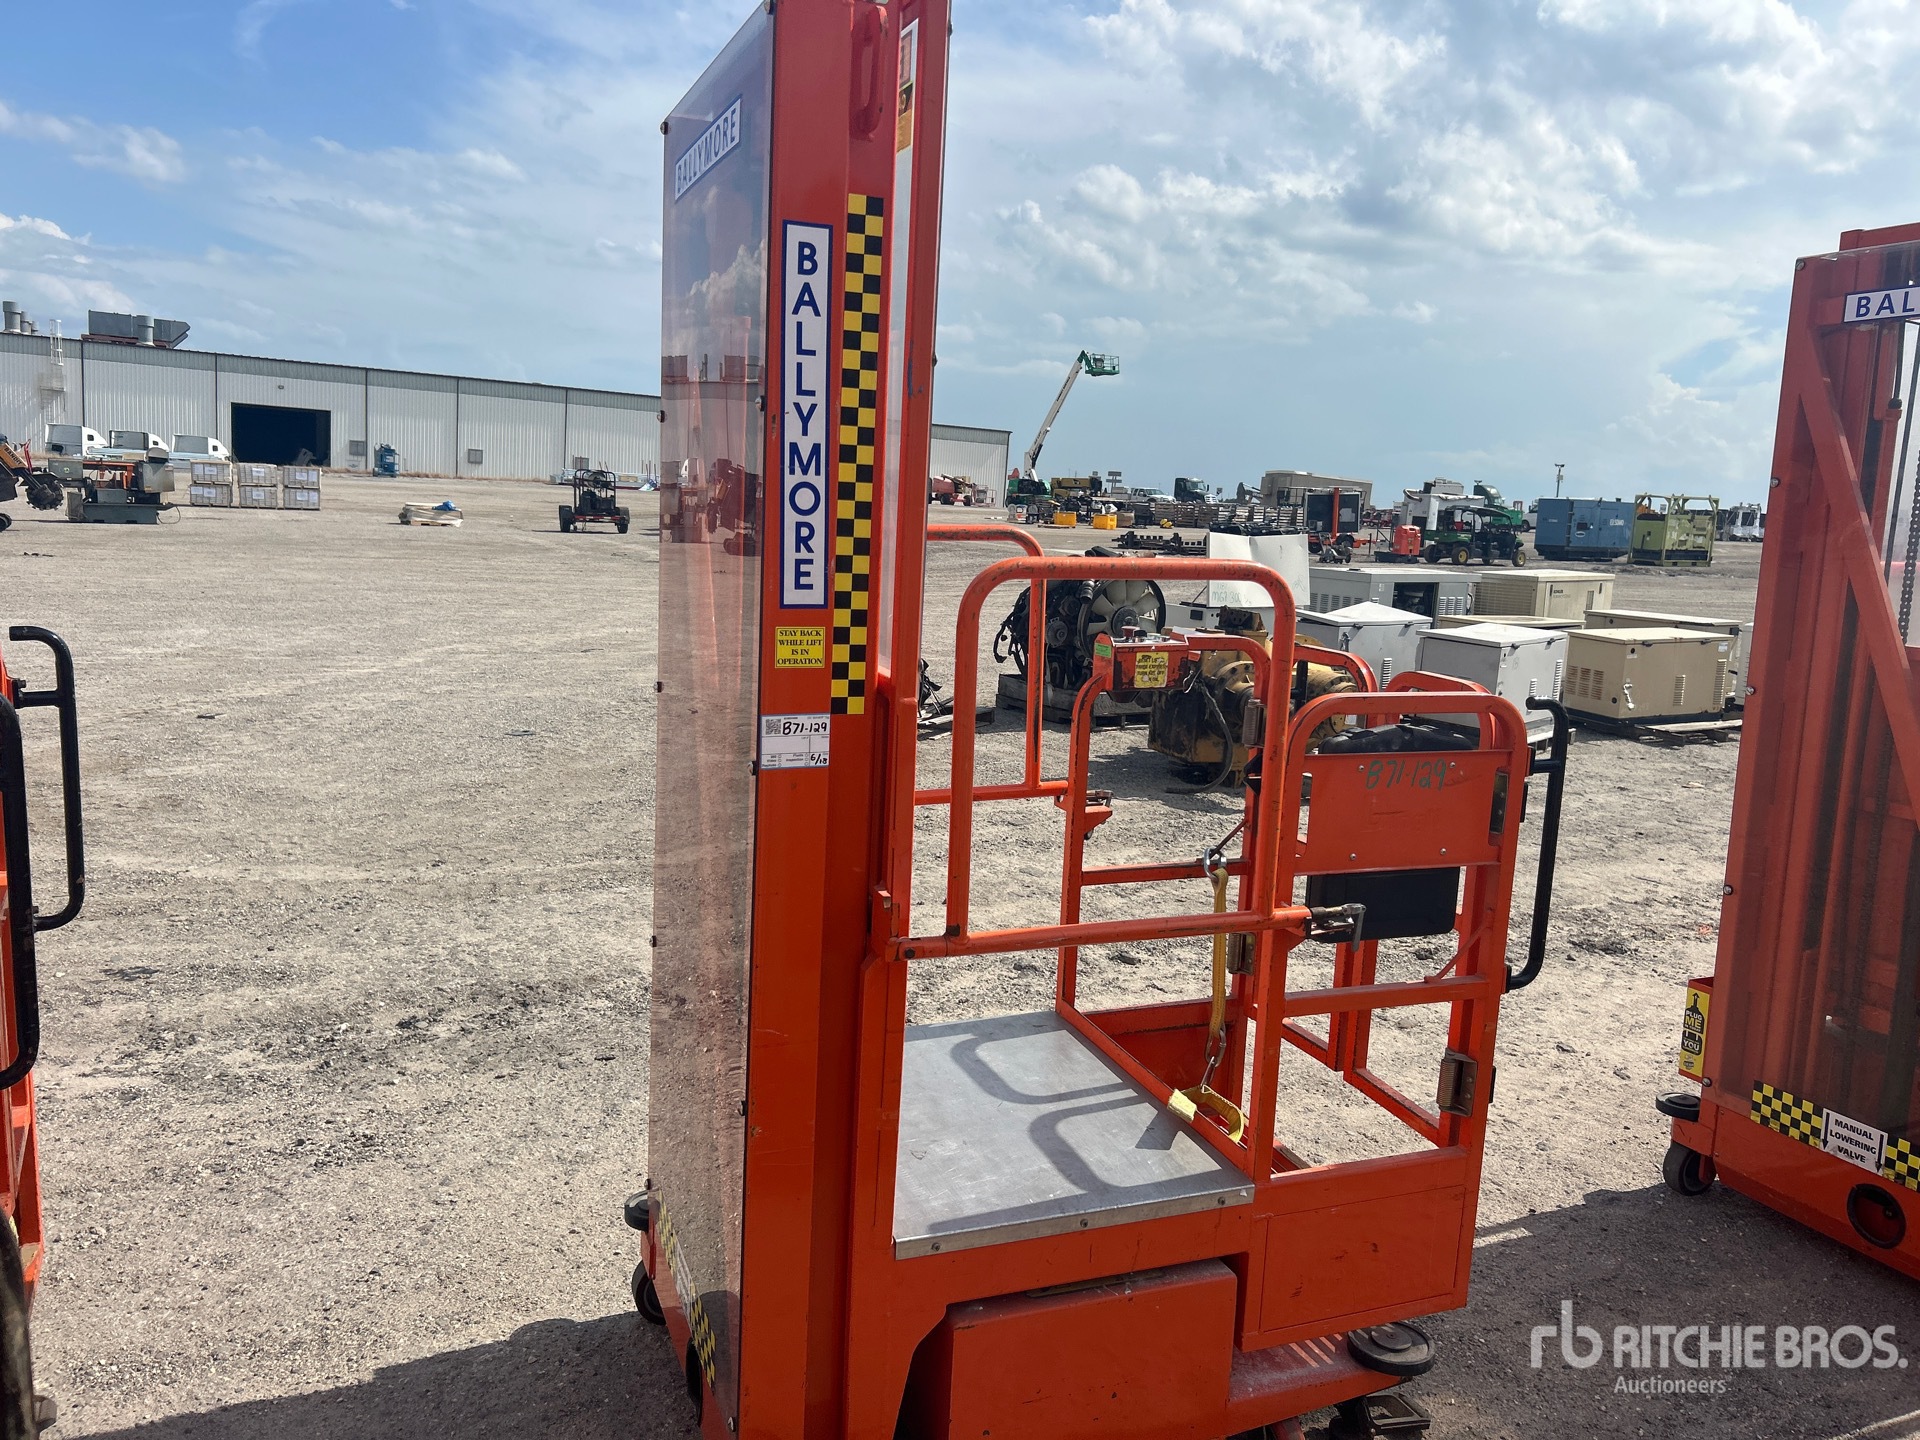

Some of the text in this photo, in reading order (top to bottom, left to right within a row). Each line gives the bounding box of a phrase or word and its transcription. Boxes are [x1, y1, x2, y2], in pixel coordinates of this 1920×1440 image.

[677, 107, 737, 194] BALLYMORE
[1856, 290, 1915, 318] BAL
[788, 241, 822, 591] BALLYMORE
[810, 753, 828, 766] 6/18
[1685, 1009, 1703, 1021] PLUG
[1685, 1016, 1702, 1029] ME
[1683, 1039, 1700, 1051] YOU
[1834, 1118, 1874, 1141] MANUAL
[1829, 1129, 1877, 1155] LOWERING
[1837, 1145, 1866, 1164] VALVE
